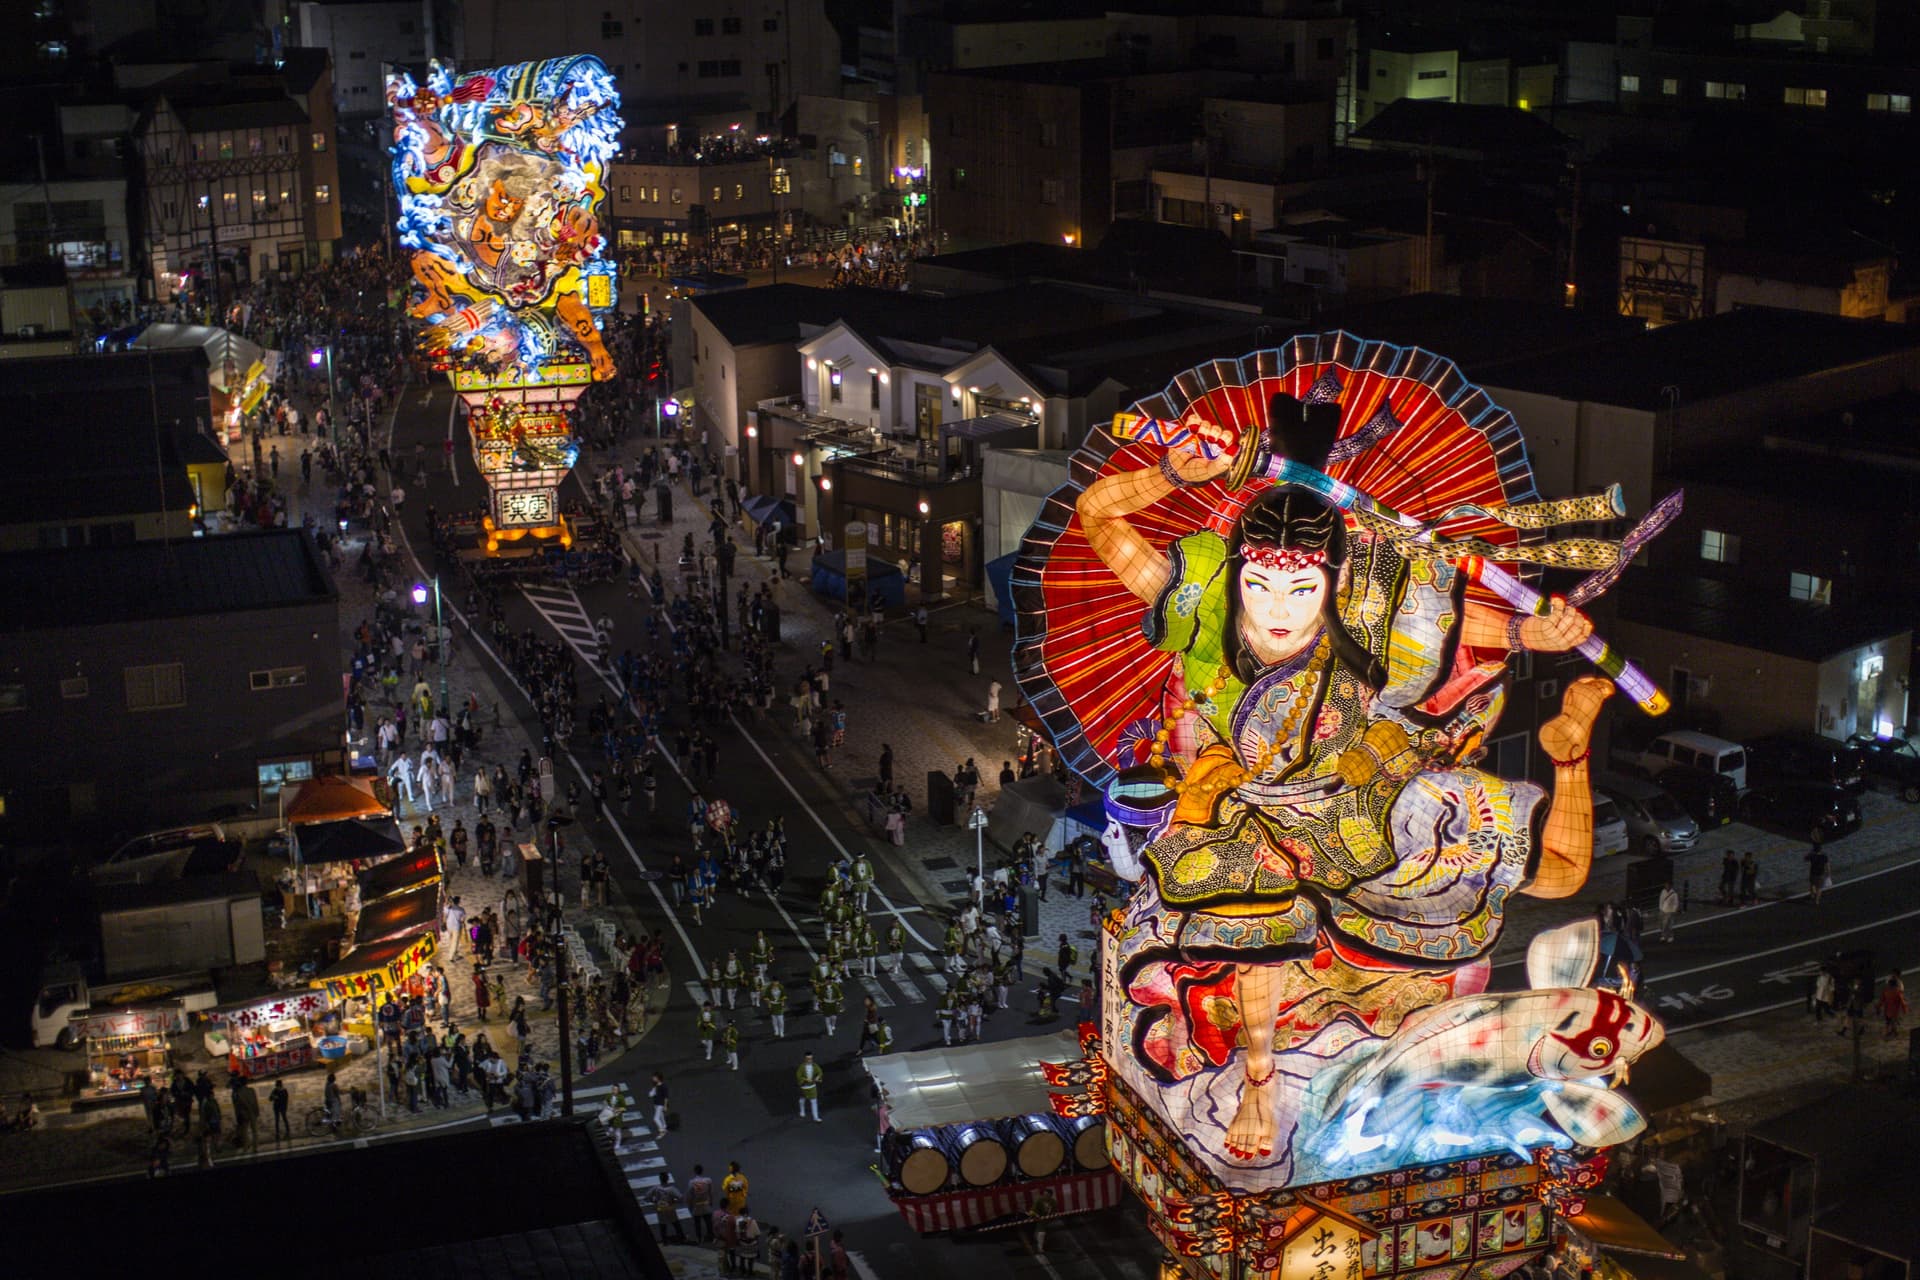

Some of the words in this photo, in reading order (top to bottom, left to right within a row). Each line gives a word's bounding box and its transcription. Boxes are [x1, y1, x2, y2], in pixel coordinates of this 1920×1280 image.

[77, 1012, 171, 1035] スーパーボール
[239, 996, 319, 1027] かき氷
